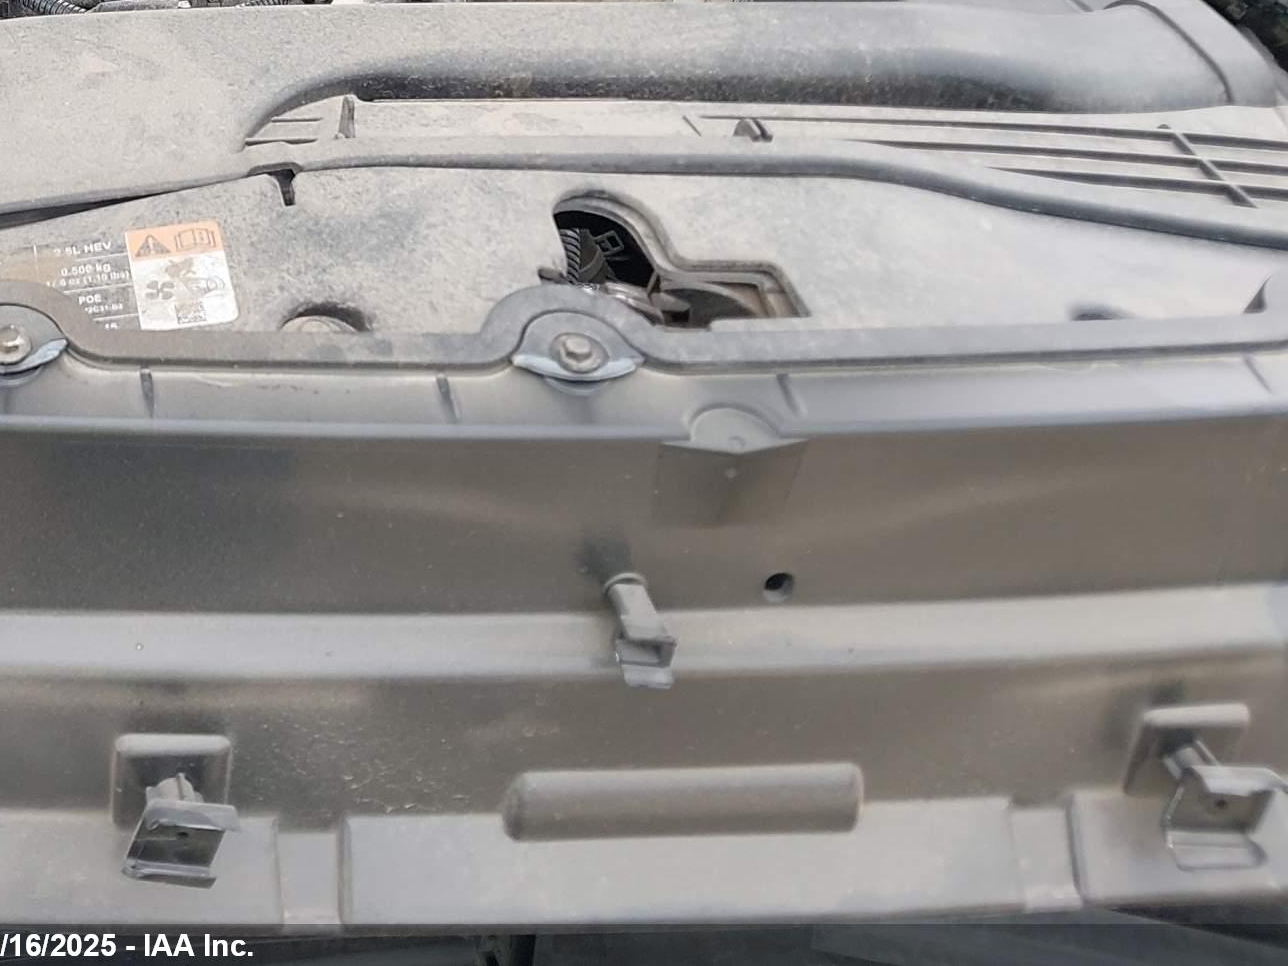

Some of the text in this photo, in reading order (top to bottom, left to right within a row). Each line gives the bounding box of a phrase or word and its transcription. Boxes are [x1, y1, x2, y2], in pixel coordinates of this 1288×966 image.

[84, 241, 112, 253] HEV
[95, 261, 112, 273] kg
[78, 293, 103, 306] POE
